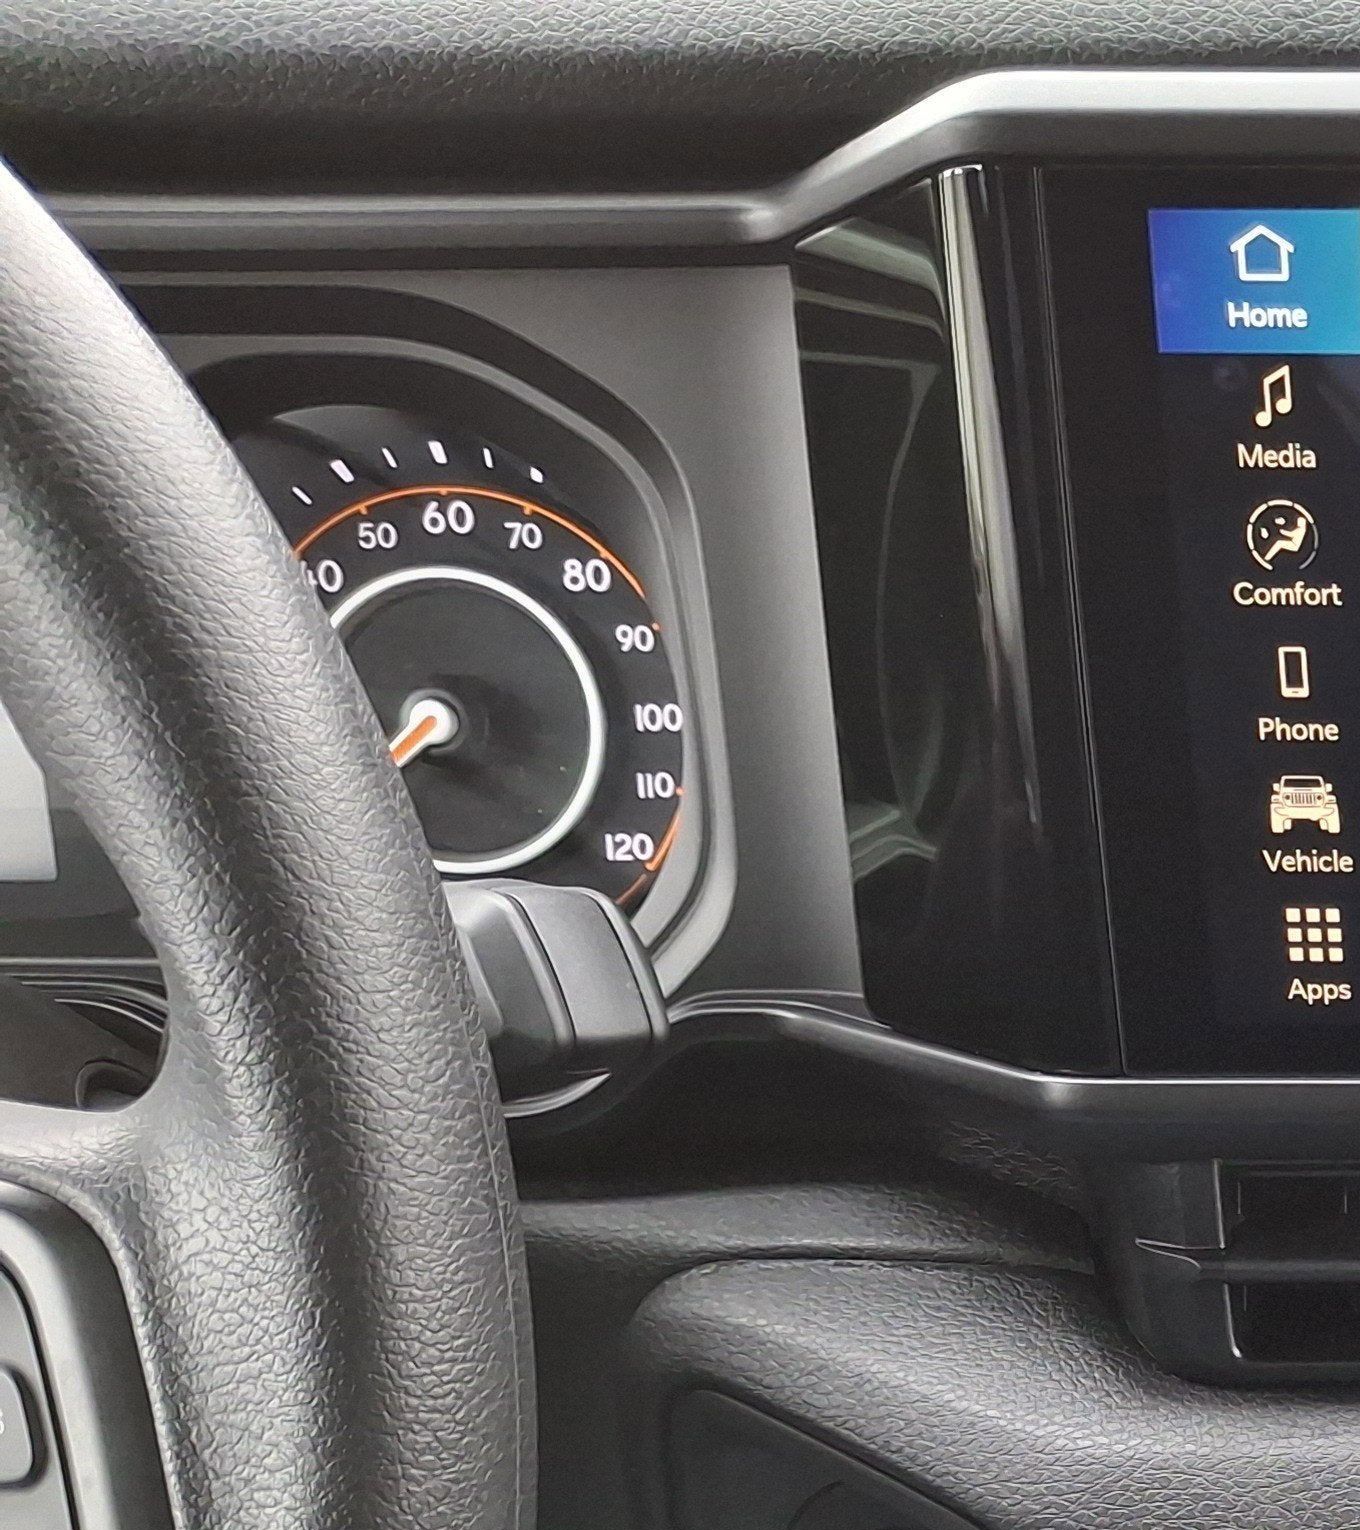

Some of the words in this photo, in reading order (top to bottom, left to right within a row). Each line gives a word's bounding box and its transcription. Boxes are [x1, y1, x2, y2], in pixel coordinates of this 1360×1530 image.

[1228, 301, 1307, 328] Home
[1237, 442, 1317, 470] Media
[422, 500, 475, 535] 60
[358, 521, 398, 550] 50
[503, 522, 543, 550] 70
[562, 559, 611, 593] 80
[1233, 581, 1343, 607] Comfort
[615, 625, 655, 653] 90
[634, 703, 683, 733] 100
[1258, 717, 1340, 741] Phone
[637, 772, 675, 800] 110
[605, 833, 654, 861] 120
[1262, 849, 1354, 873] Vehicle
[1288, 979, 1352, 1006] Apps
